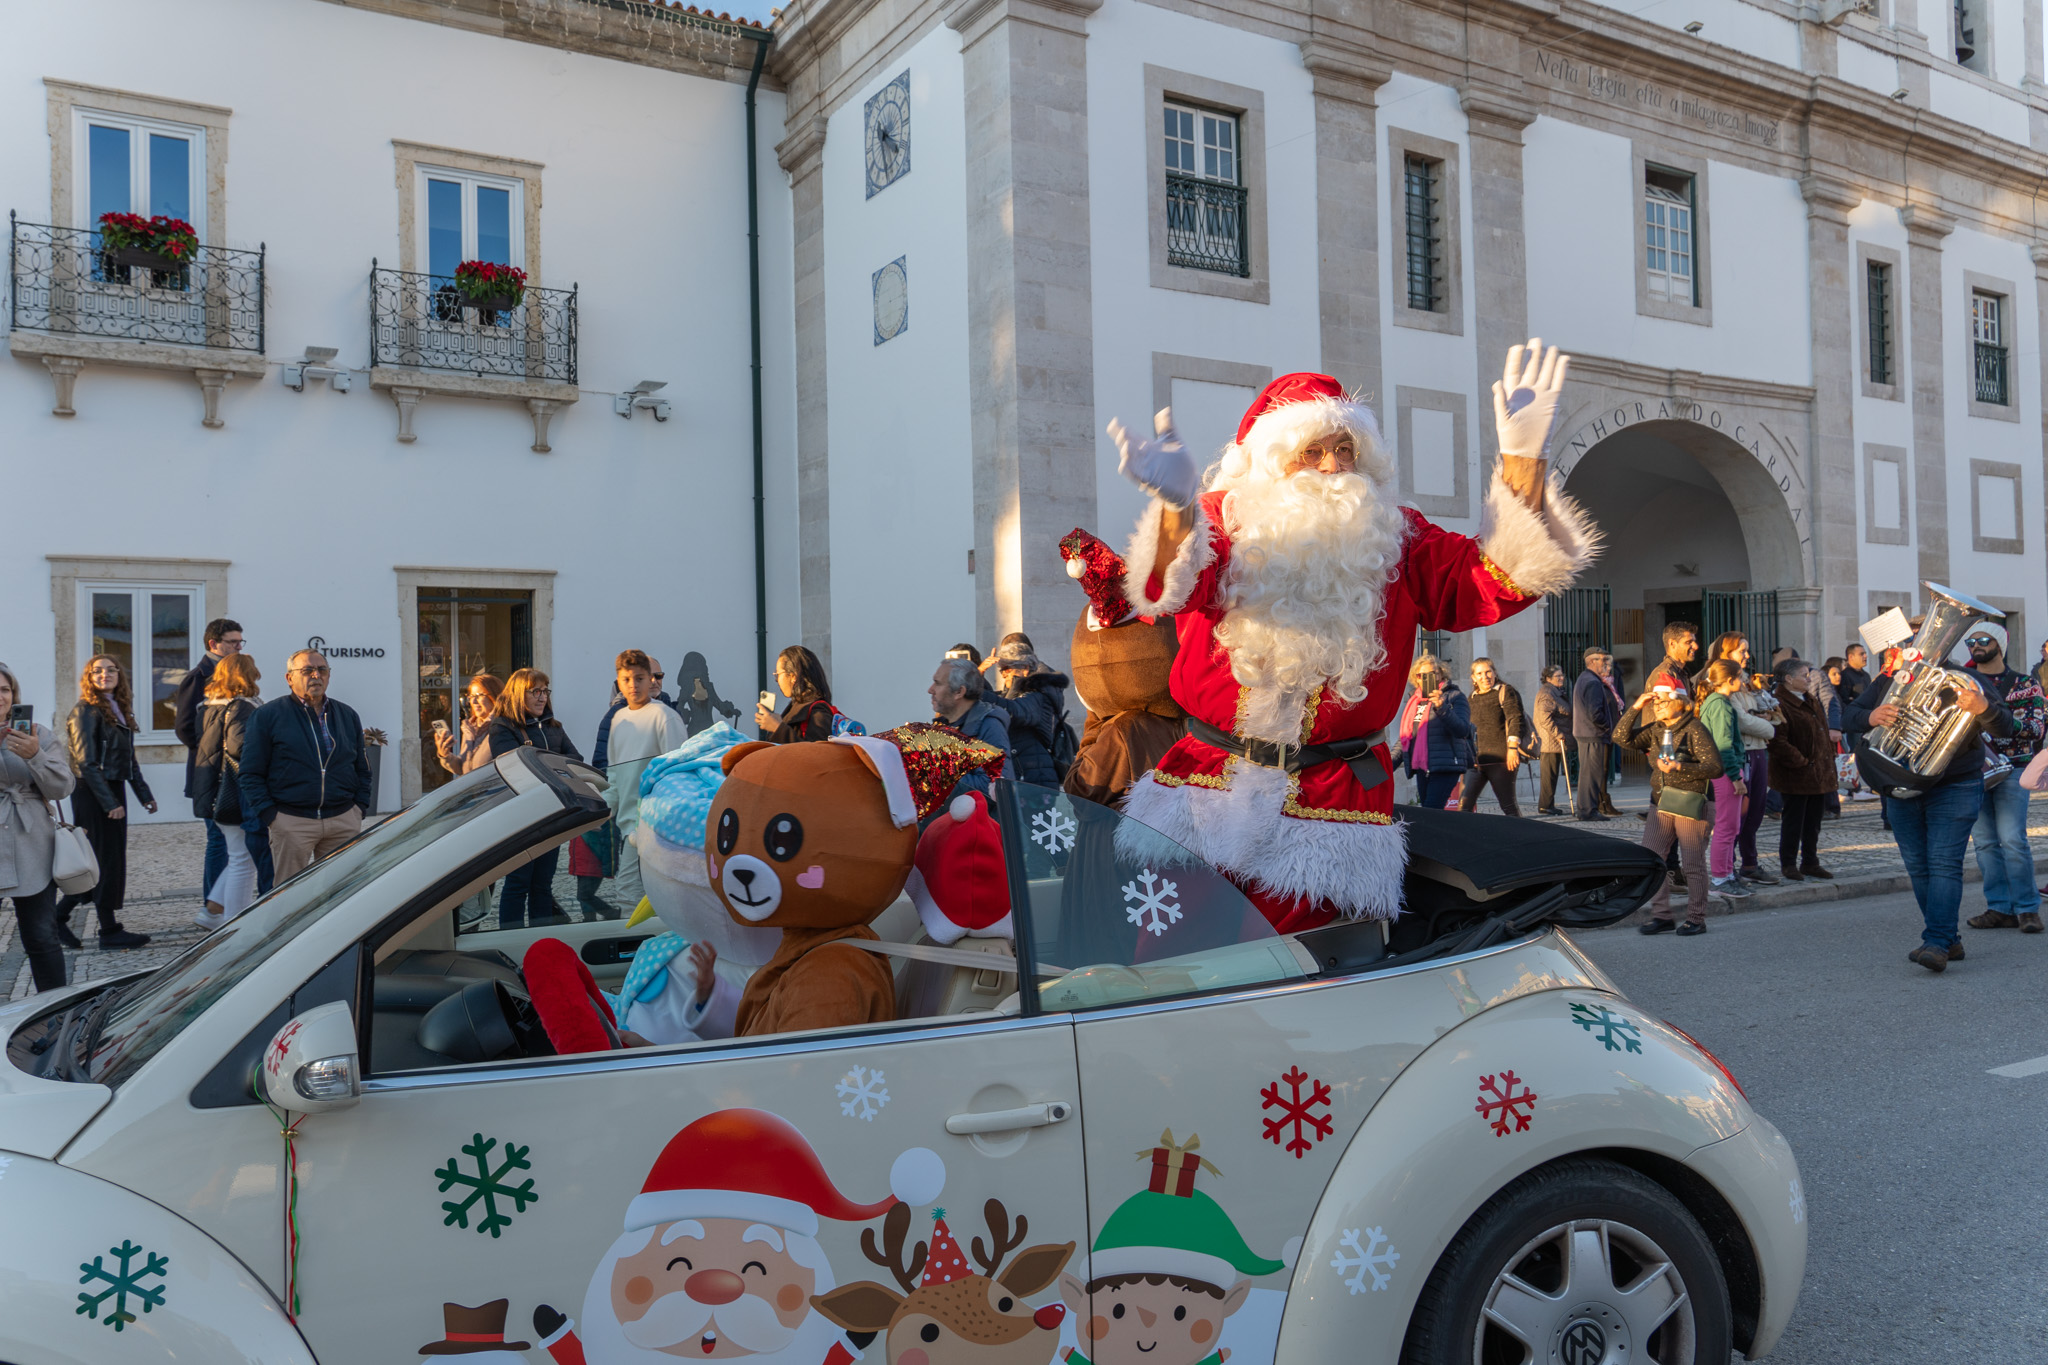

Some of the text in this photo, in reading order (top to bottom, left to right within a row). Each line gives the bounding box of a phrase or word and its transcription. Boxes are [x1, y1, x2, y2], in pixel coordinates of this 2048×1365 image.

[1588, 66, 1626, 100] Igreja
[1670, 98, 1679, 113] a
[1555, 400, 1811, 555] ENHORA DO CARDAL
[321, 647, 385, 658] TURISMO
